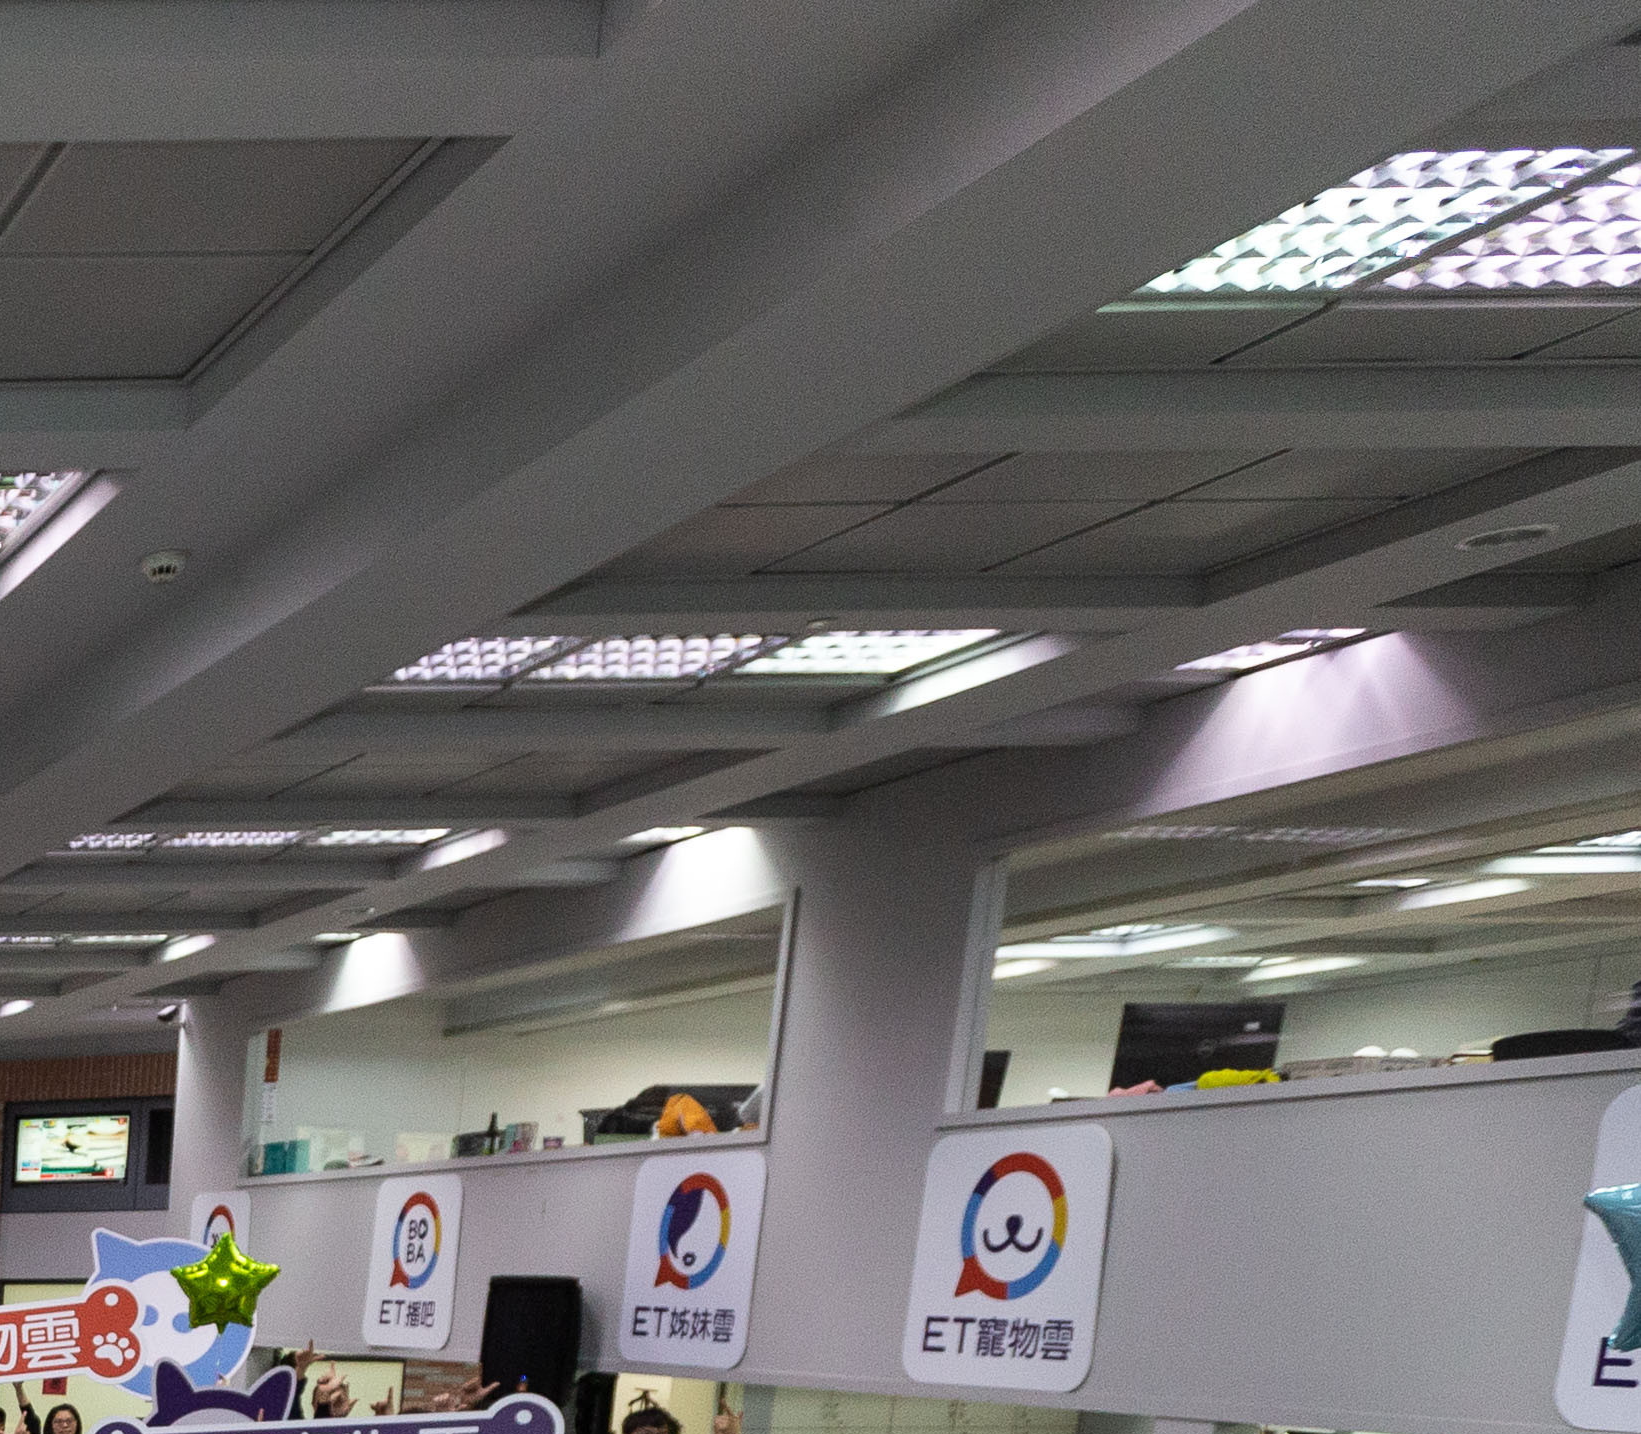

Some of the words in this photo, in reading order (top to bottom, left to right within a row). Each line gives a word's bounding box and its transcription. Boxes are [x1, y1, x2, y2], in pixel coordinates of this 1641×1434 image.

[379, 1299, 437, 1328] ET播吧
[922, 1316, 1075, 1361] ET寵物雲
